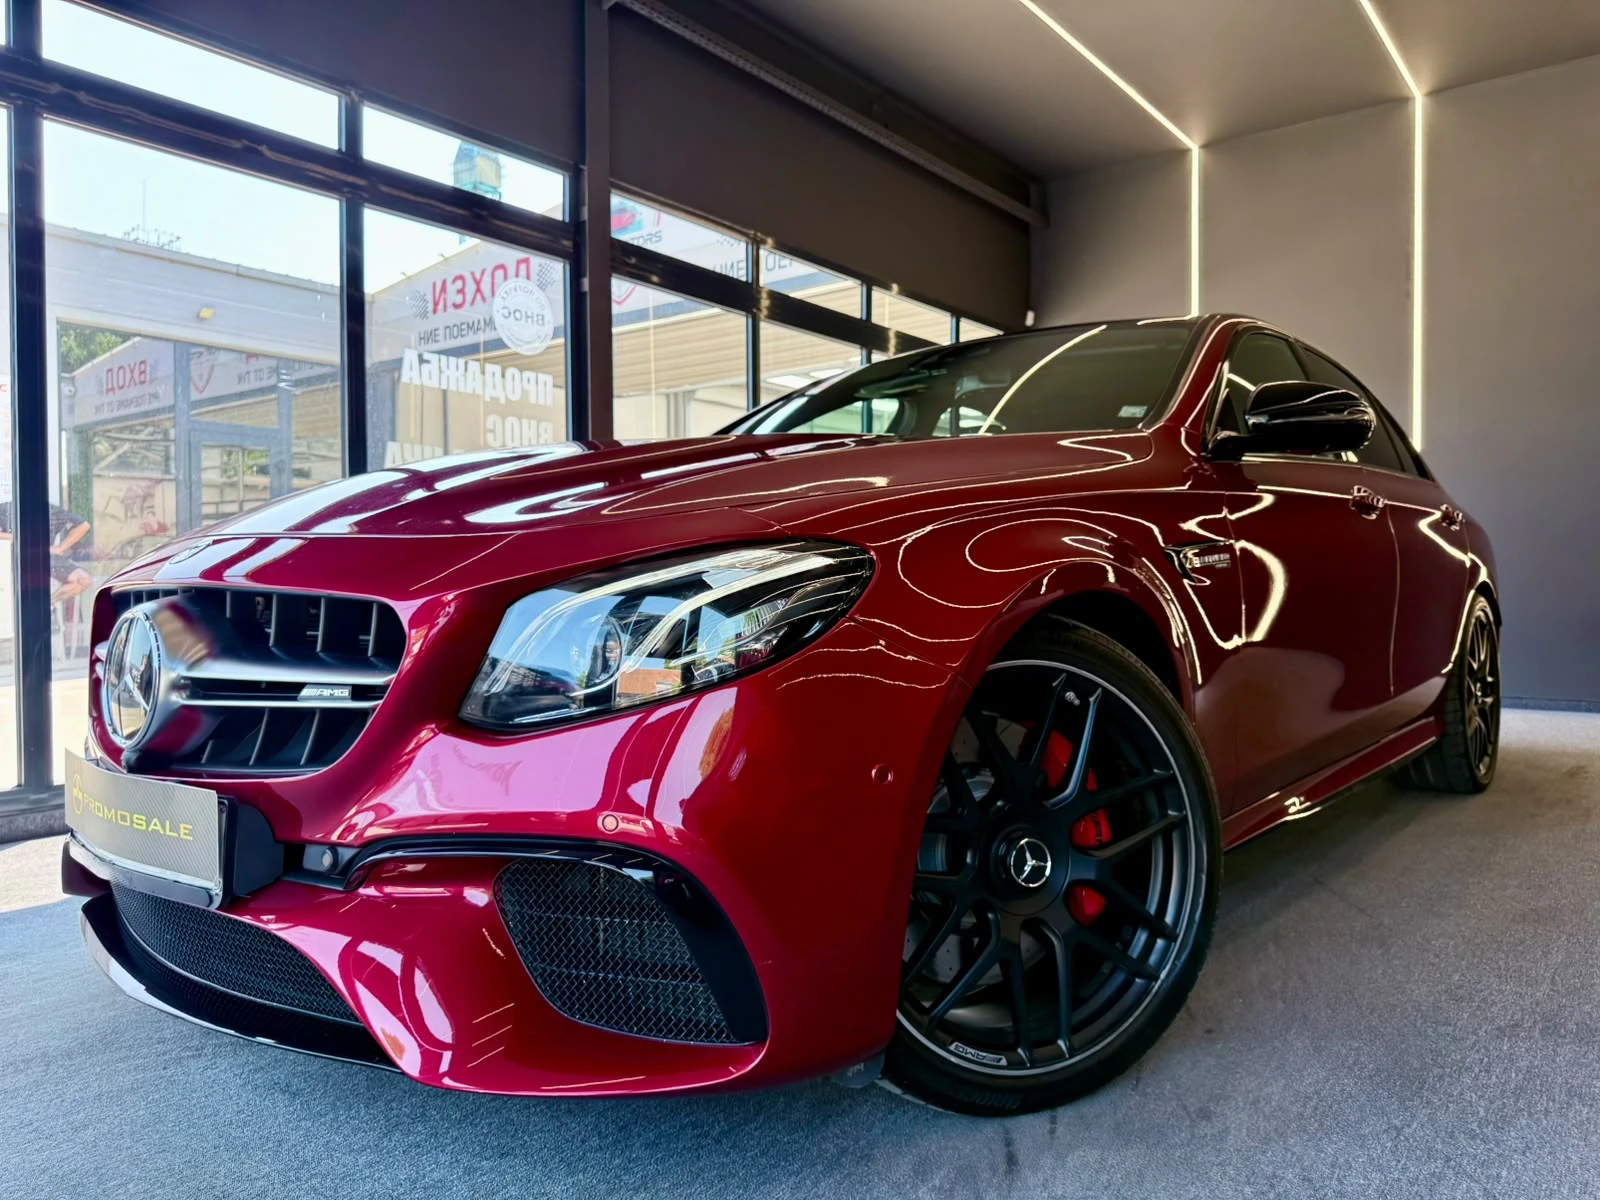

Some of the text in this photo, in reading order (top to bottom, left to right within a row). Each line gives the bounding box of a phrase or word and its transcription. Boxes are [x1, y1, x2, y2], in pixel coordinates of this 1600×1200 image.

[630, 231, 662, 248] TORS
[418, 327, 441, 345] НИЕ
[311, 688, 350, 697] AMG
[83, 793, 193, 841] PROMOSALE
[953, 1043, 988, 1061] AMG
